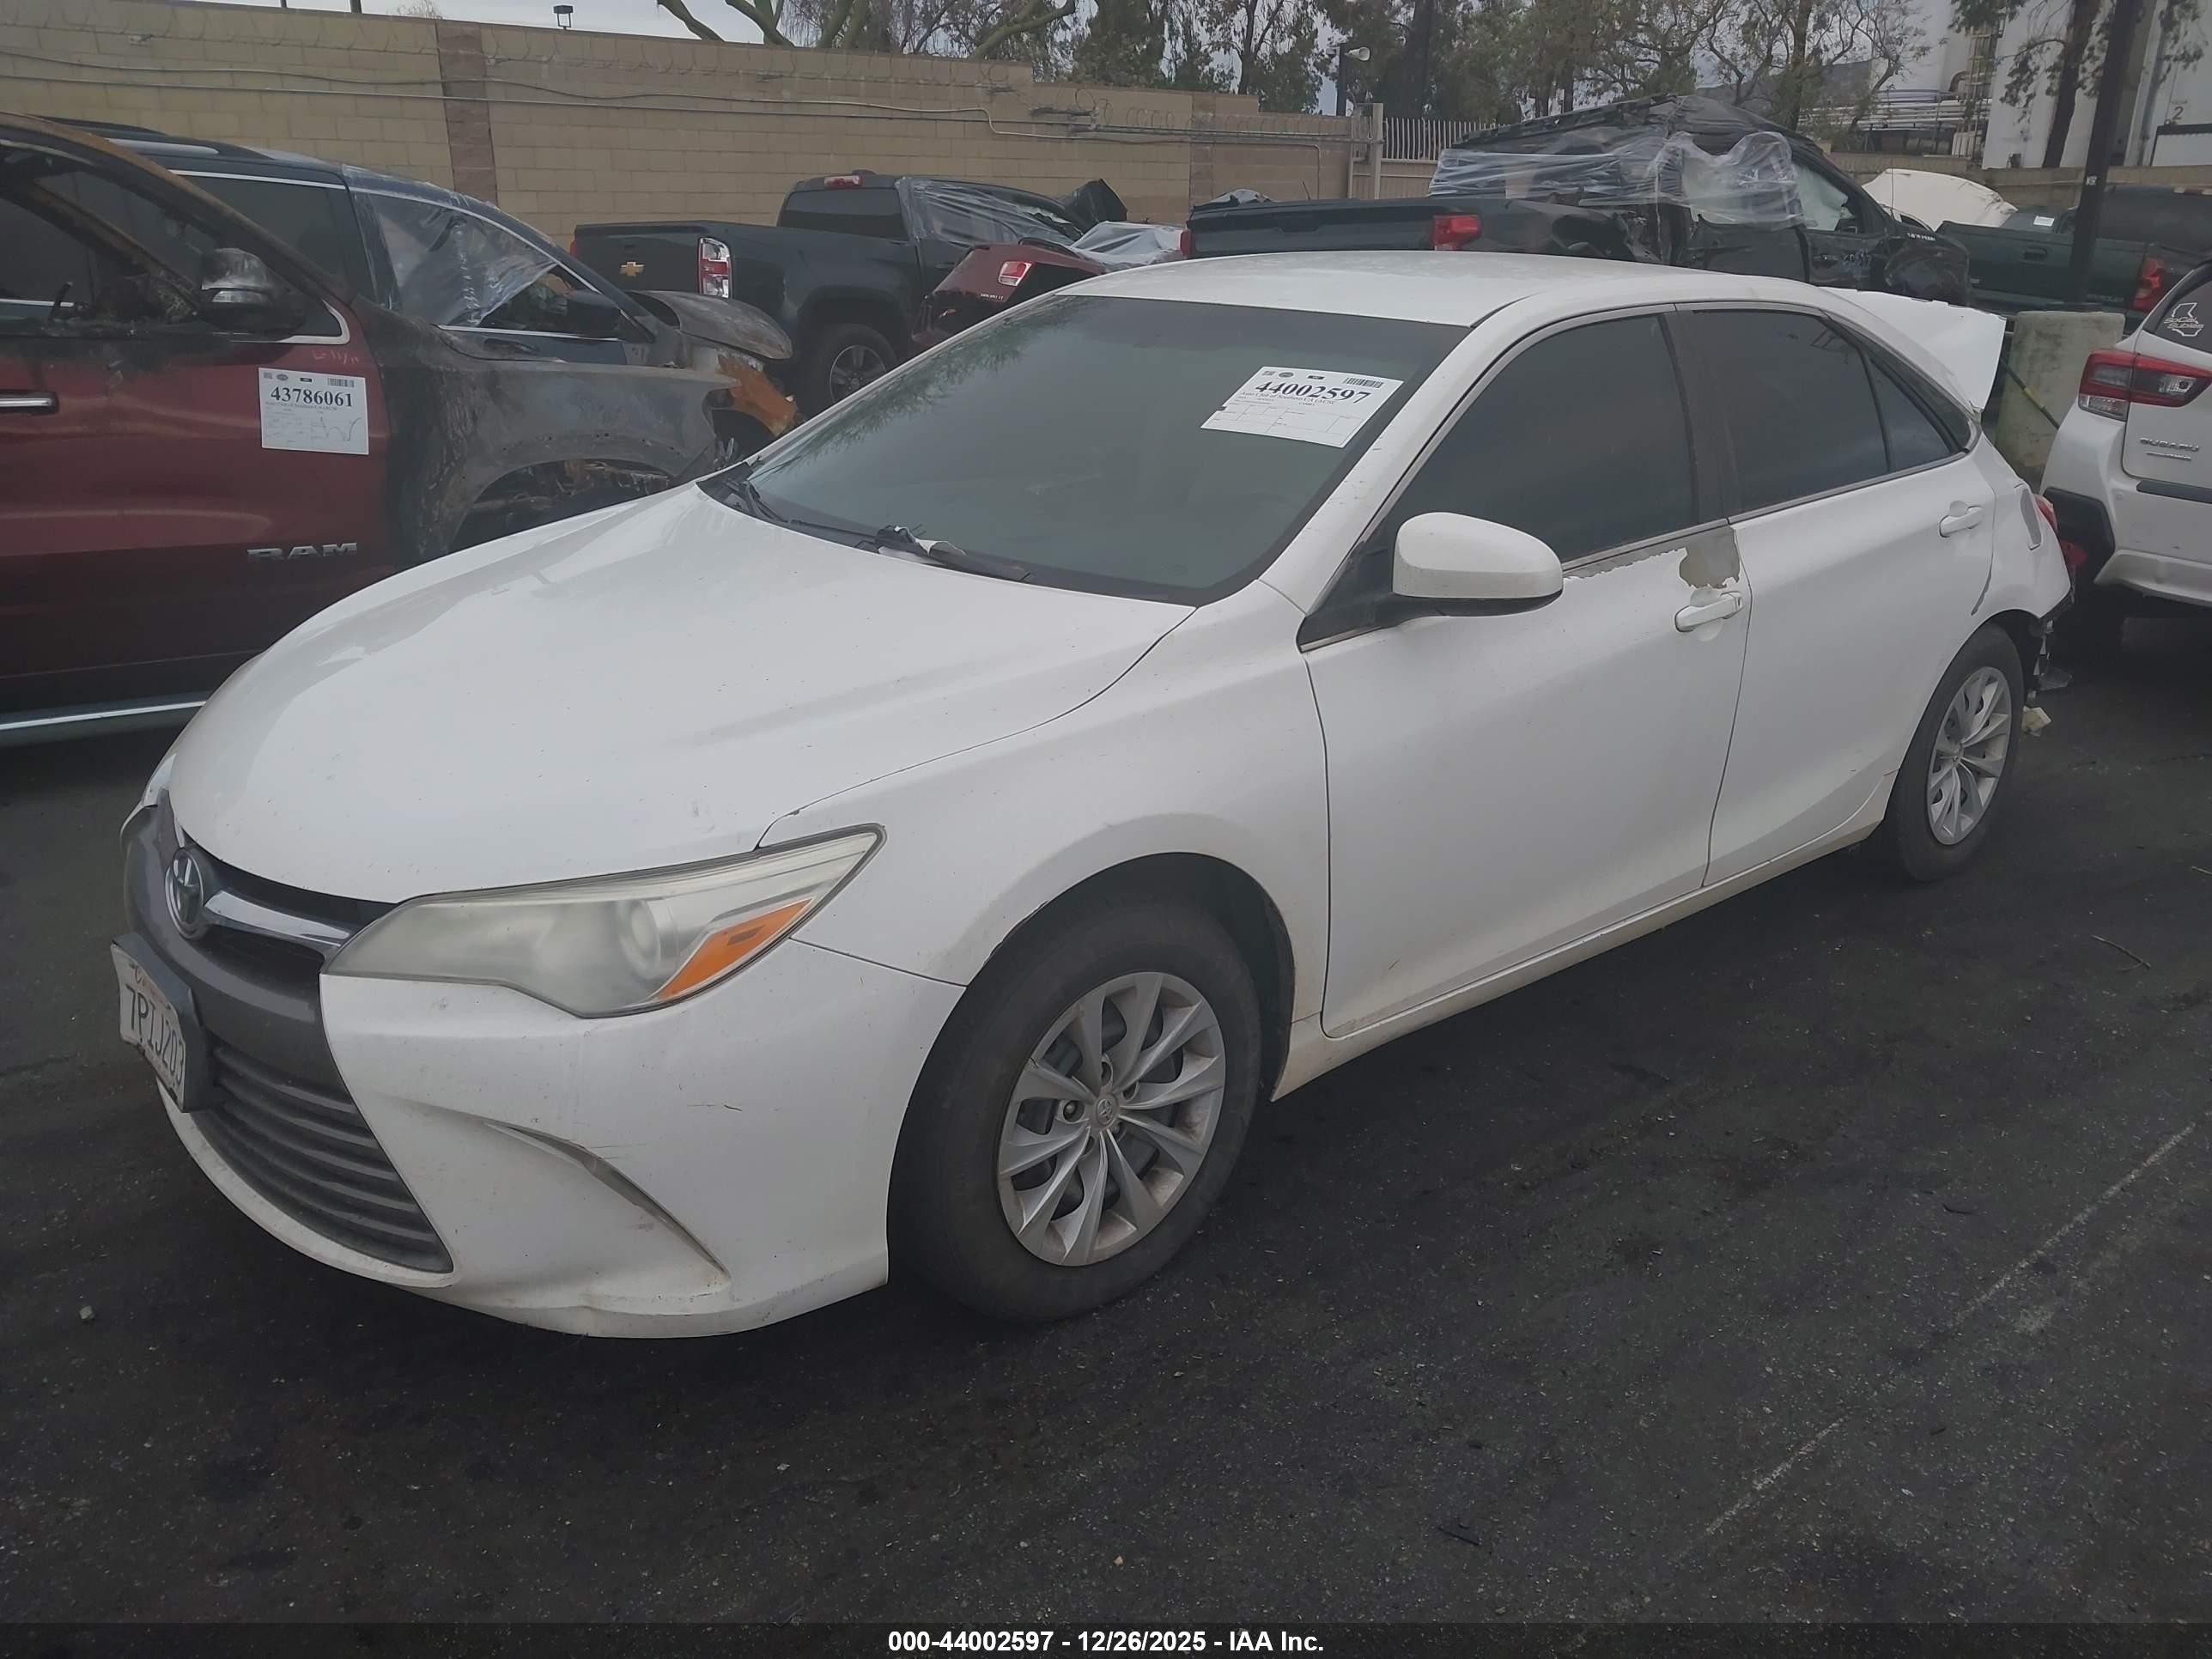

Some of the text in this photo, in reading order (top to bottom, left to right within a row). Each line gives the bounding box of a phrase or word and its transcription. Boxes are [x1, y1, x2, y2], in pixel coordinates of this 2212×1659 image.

[2172, 106, 2185, 120] 2
[270, 386, 352, 406] 43786061
[1255, 381, 1371, 404] 44002597
[247, 543, 357, 563] RAM
